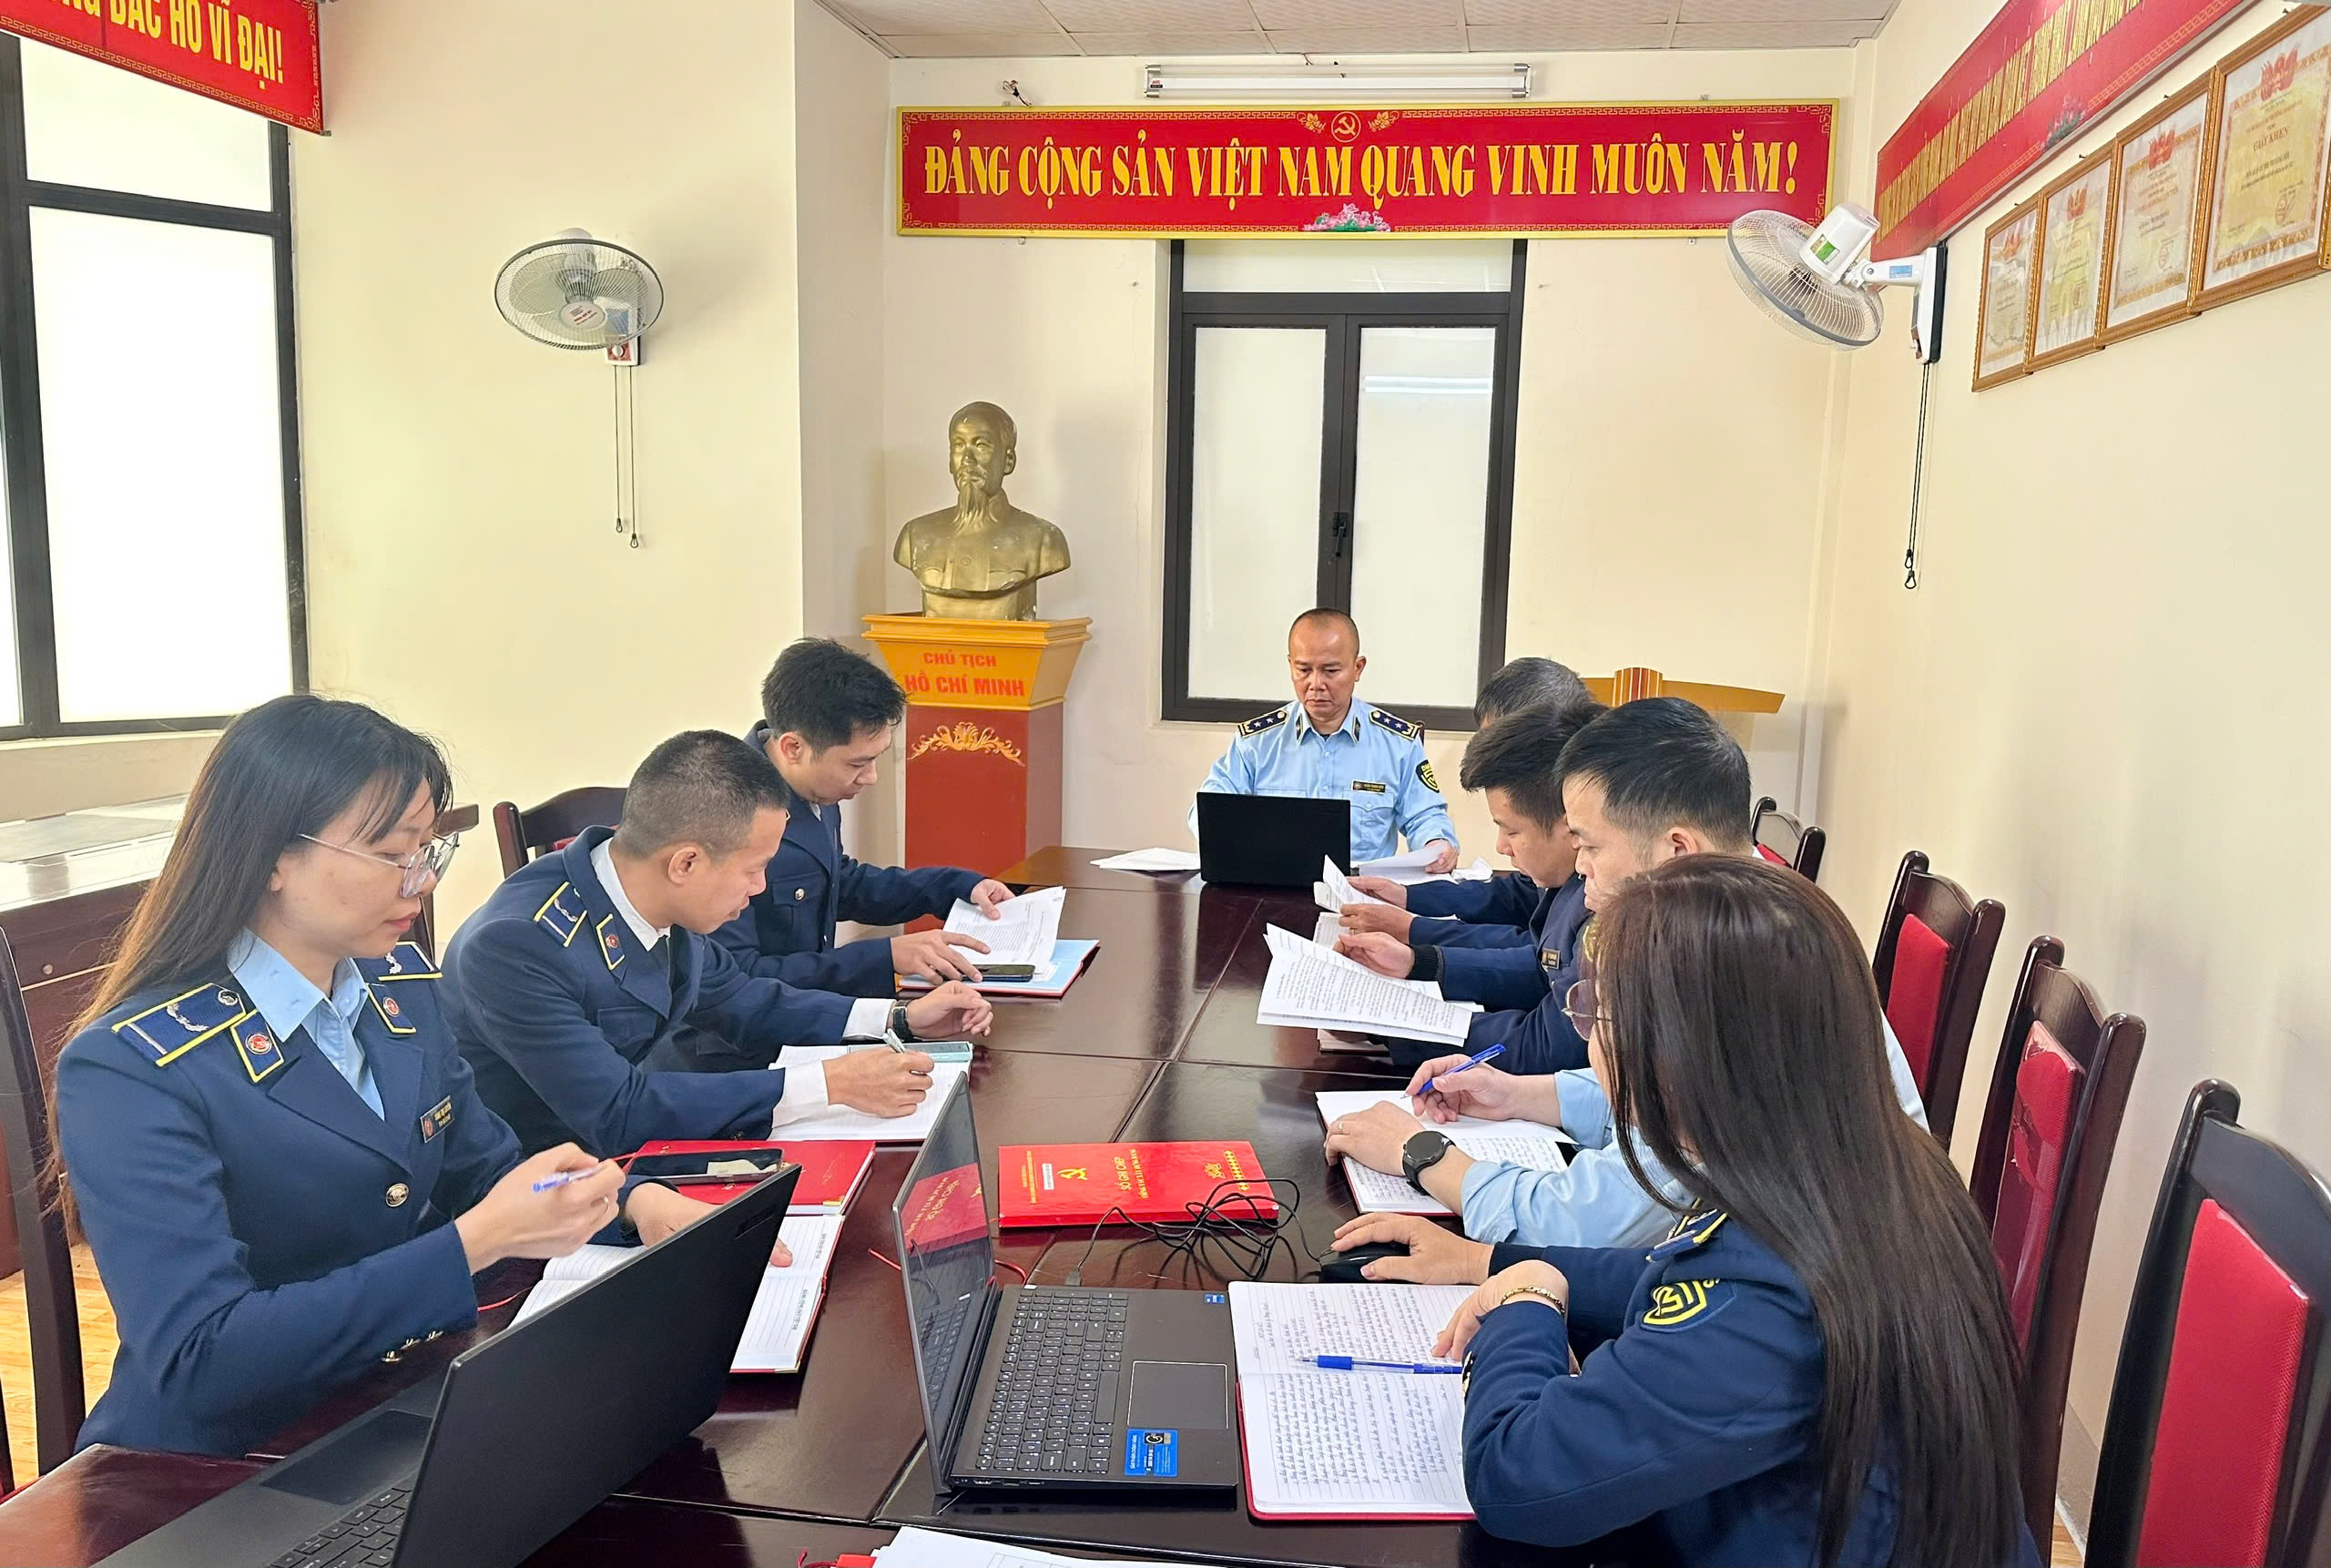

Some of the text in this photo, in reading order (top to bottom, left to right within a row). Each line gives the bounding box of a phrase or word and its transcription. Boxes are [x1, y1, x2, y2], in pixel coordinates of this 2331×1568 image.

[237, 14, 284, 89] ĐẠI!
[924, 127, 1798, 211] ĐẢNG CỘNG SẢN VIỆT NAM QUANG VINH MUÔN NĂM!
[961, 653, 997, 667] TỊCH
[935, 674, 968, 694] CHÍ
[973, 677, 1024, 697] MINH
